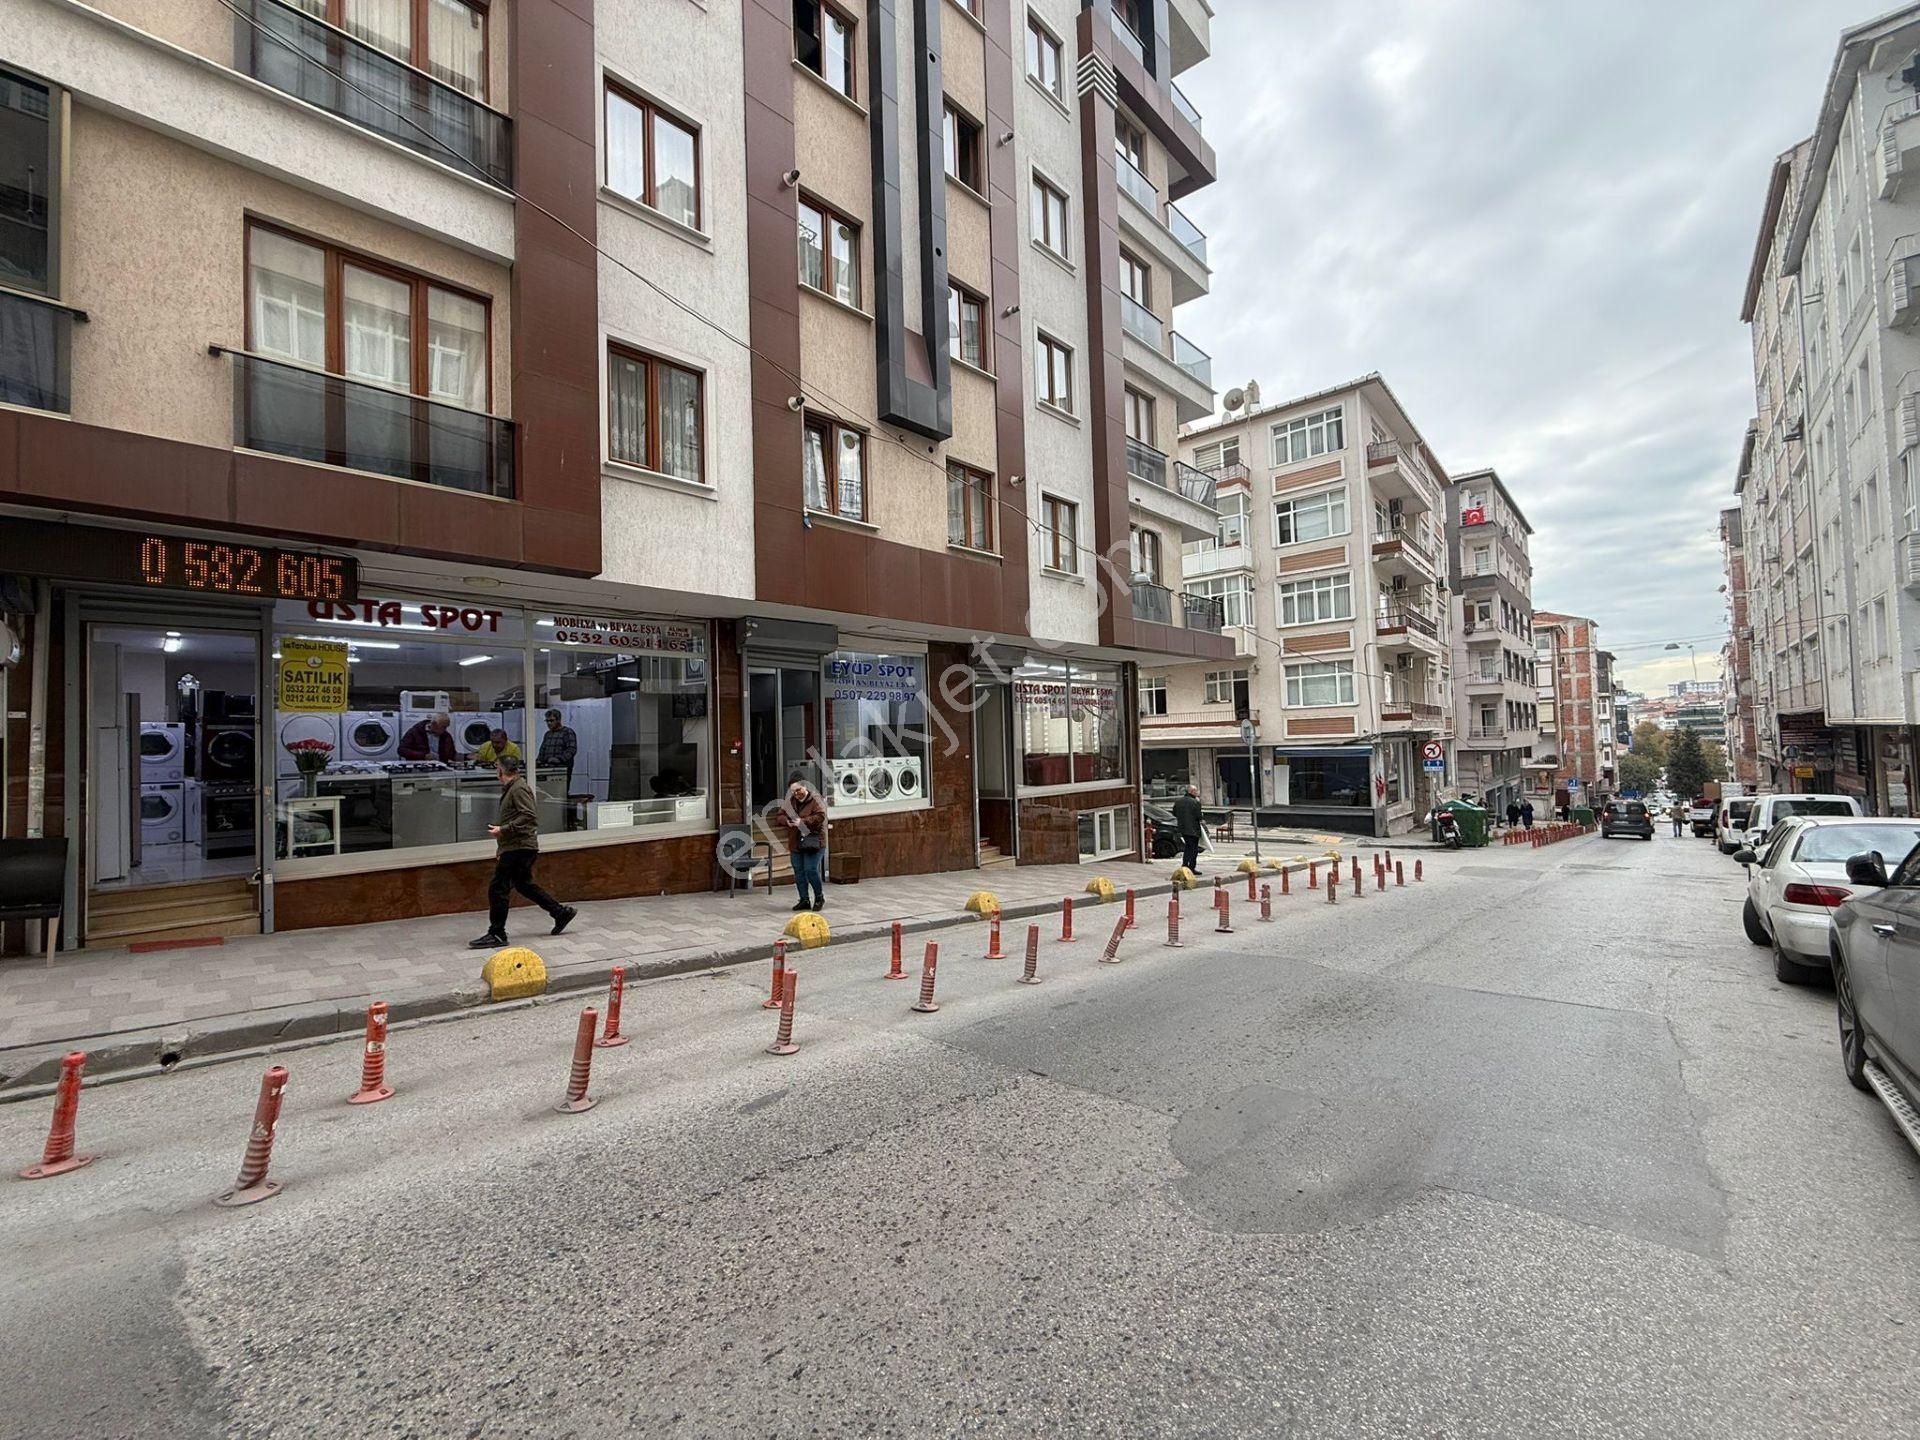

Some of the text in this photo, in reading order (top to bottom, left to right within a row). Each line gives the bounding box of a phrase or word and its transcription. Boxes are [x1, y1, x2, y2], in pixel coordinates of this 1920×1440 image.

[142, 538, 342, 599] 0 532 605
[308, 599, 503, 632] USTA SPOT
[553, 615, 596, 630] MOBİLYA
[610, 621, 638, 633] BEYAZ
[556, 630, 603, 644] 0532
[609, 634, 640, 648] 605
[669, 640, 687, 650] 65
[284, 670, 343, 685] SATILIK
[879, 664, 914, 677] SPOT
[285, 684, 304, 693] 0532
[306, 685, 319, 694] 227
[834, 689, 916, 702] 0507 229 98 97
[1015, 682, 1066, 695] USTA SPOT
[285, 694, 304, 702] 0212
